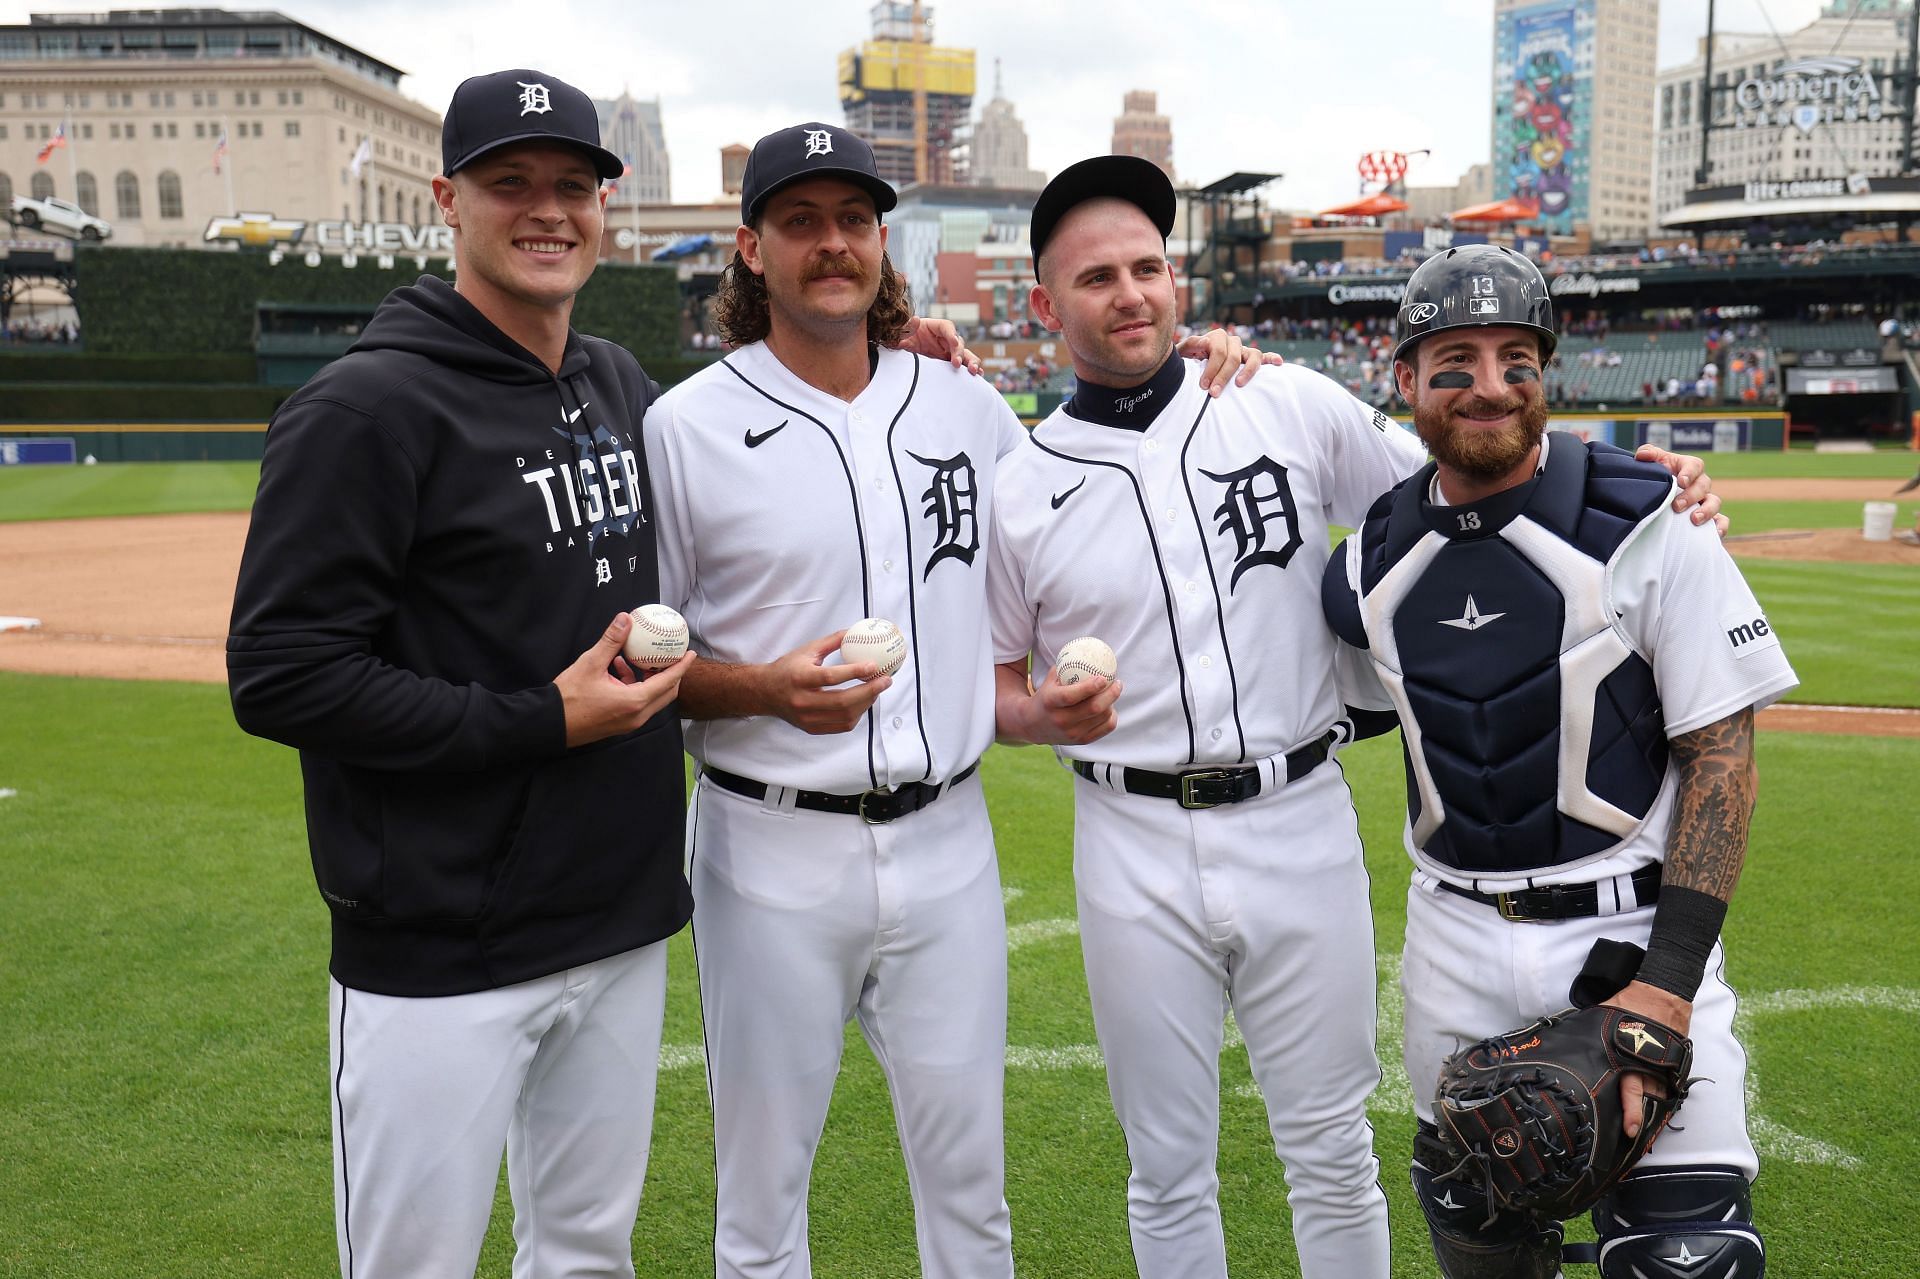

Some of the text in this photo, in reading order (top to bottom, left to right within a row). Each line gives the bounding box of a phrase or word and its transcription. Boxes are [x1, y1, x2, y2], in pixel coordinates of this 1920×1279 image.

[516, 81, 553, 117] D
[803, 129, 834, 160] D
[1472, 277, 1495, 295] 13
[1114, 388, 1154, 413] Tigers
[904, 449, 980, 584] D
[1197, 454, 1305, 597] D
[1456, 511, 1482, 531] 13
